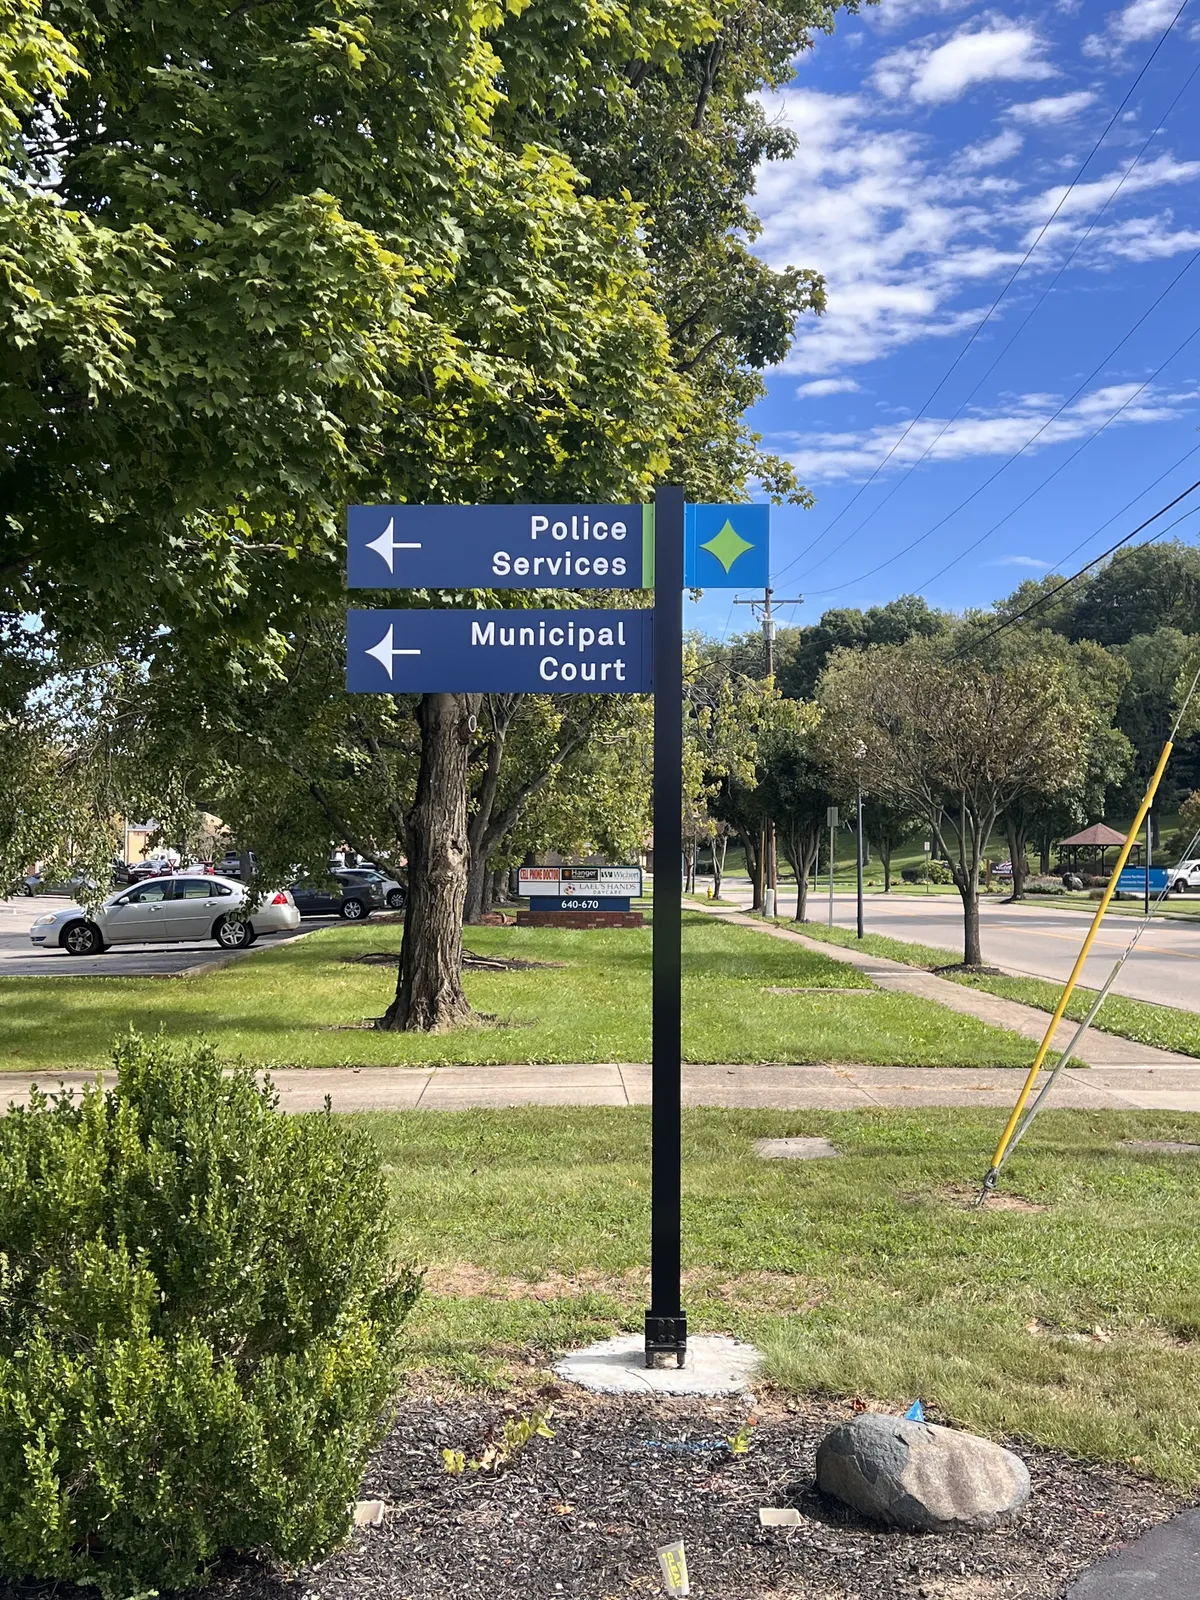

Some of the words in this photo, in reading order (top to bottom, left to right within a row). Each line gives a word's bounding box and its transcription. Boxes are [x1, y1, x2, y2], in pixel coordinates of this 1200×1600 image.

[531, 515, 627, 541] Police
[492, 551, 627, 576] Services
[471, 621, 626, 652] Municipal
[539, 656, 626, 681] Court
[530, 869, 543, 880] PHONE
[543, 869, 559, 880] DOCTOR
[571, 869, 597, 878] Hanger
[561, 900, 599, 909] 640-670
[667, 1552, 682, 1587] CLEAR
